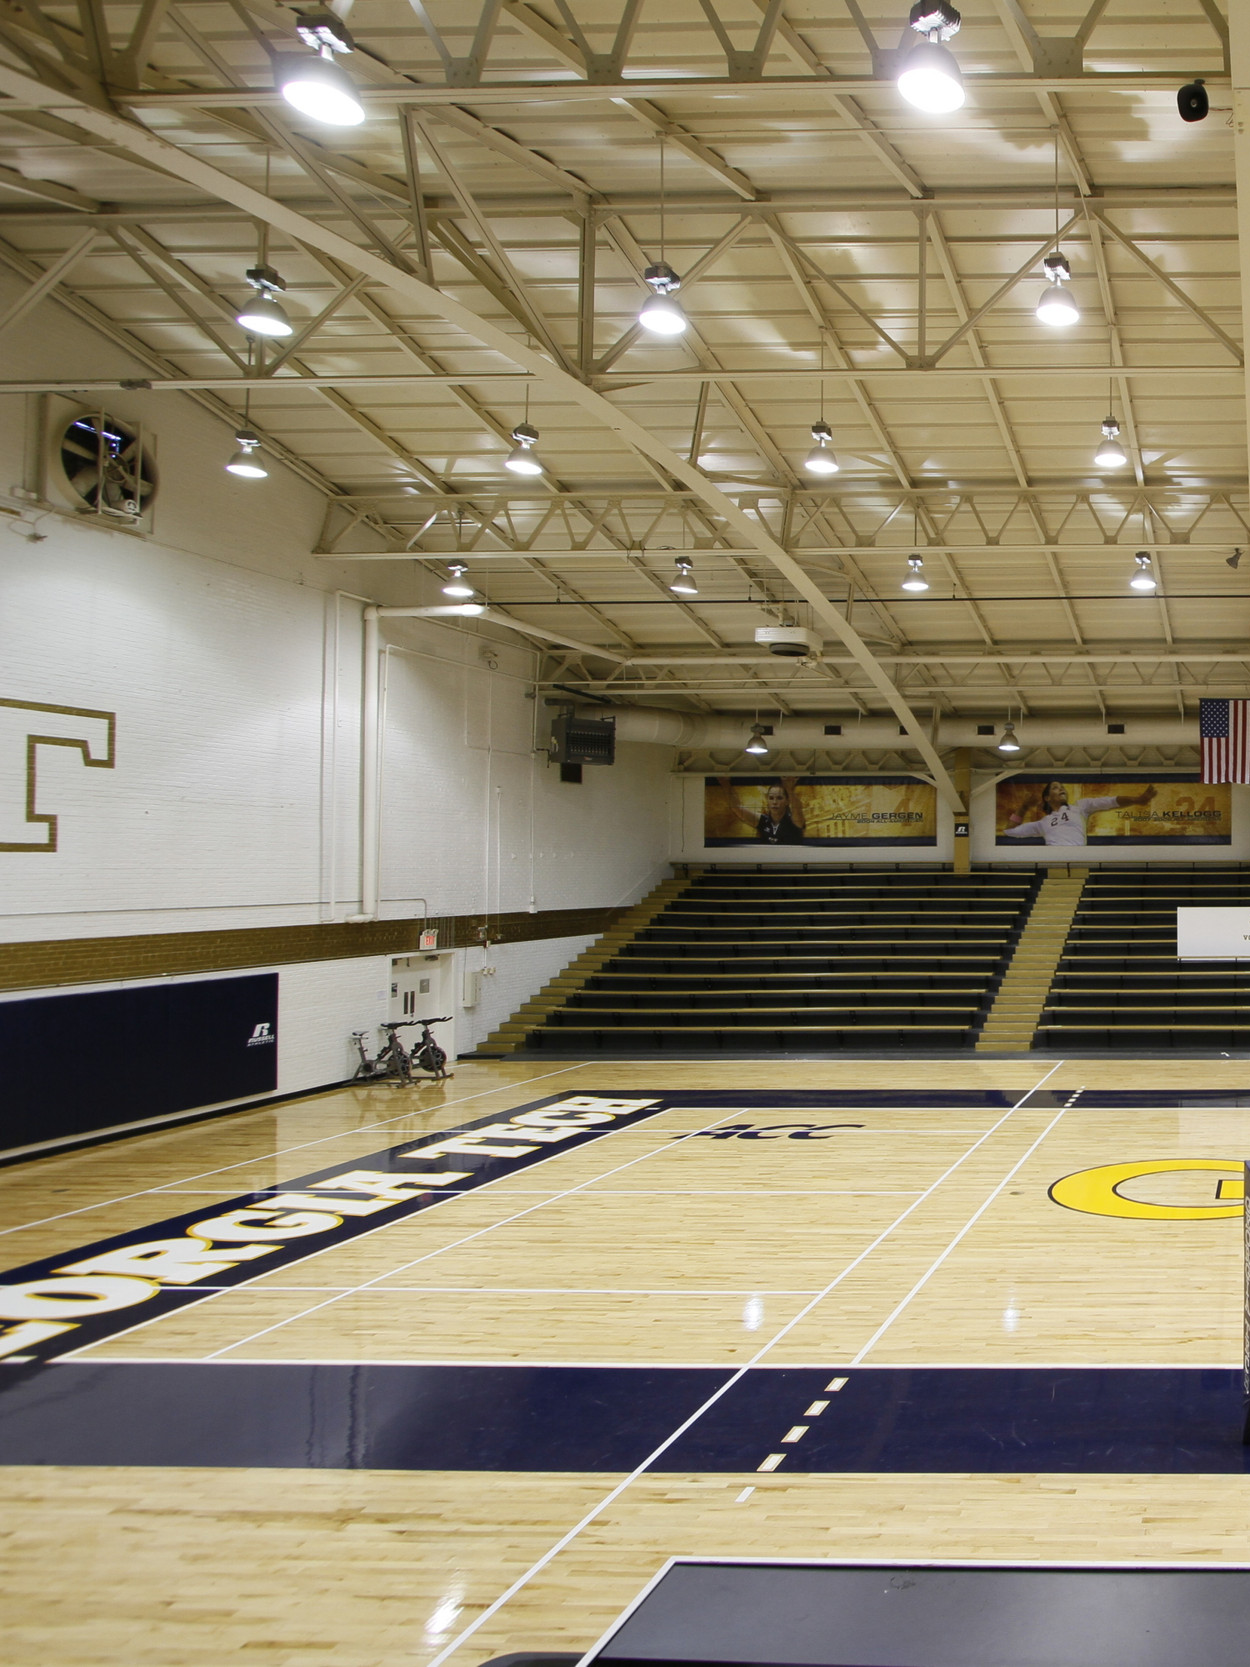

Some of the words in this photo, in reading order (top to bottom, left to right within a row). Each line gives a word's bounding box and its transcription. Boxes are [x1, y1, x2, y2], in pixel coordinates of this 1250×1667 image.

[831, 812, 868, 820] JAYME
[872, 812, 924, 820] GERGEN
[1162, 810, 1222, 818] KELLOGG
[397, 1095, 664, 1159] TECH
[668, 1124, 866, 1140] ACC
